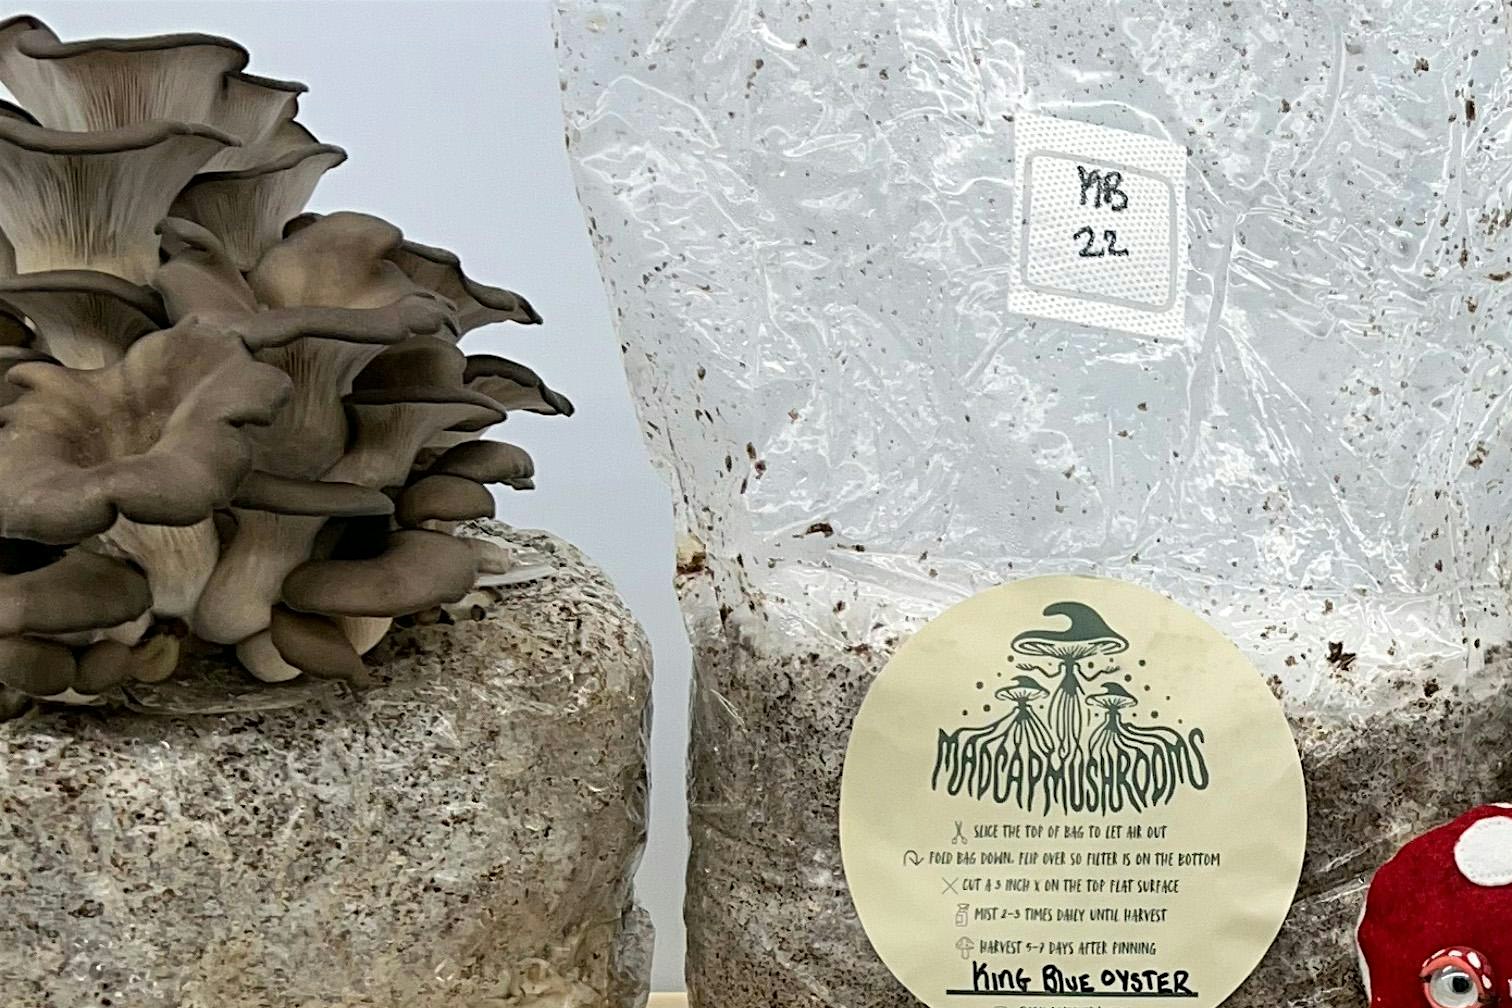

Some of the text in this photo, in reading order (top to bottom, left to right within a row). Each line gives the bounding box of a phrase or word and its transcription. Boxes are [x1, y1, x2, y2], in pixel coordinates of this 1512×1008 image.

[1073, 226, 1129, 257] 22
[974, 824, 1167, 839] SLICE THE TOP OF BAG TO LET AIR OUT
[929, 851, 953, 865] FOLD
[956, 851, 976, 865] BAG
[1019, 852, 1038, 865] FLIP
[1043, 851, 1065, 865] OVER
[1071, 852, 1081, 865] SO
[1087, 852, 1117, 866] FILTER
[1123, 853, 1130, 865] IS
[1136, 852, 1150, 865] ON
[1155, 852, 1174, 866] THE
[1179, 852, 1220, 866] BOTTOM
[962, 878, 982, 891] CUT
[985, 879, 991, 892] A
[1005, 878, 1029, 891] INCH
[1035, 880, 1040, 891] X
[1045, 879, 1059, 892] ON
[1064, 879, 1082, 892] THE
[1087, 879, 1105, 892] TOP
[1110, 879, 1134, 893] FLAT
[1137, 879, 1179, 894] SURFACE
[974, 907, 1167, 923] MIST 2-3 TIMES DAILY UNTIL HARVEST
[980, 940, 1023, 954] HARVEST
[1049, 941, 1073, 955] DAYS
[1078, 941, 1107, 955] AFTER
[1112, 942, 1156, 955] PINNING
[1101, 969, 1194, 997] OYSTER
